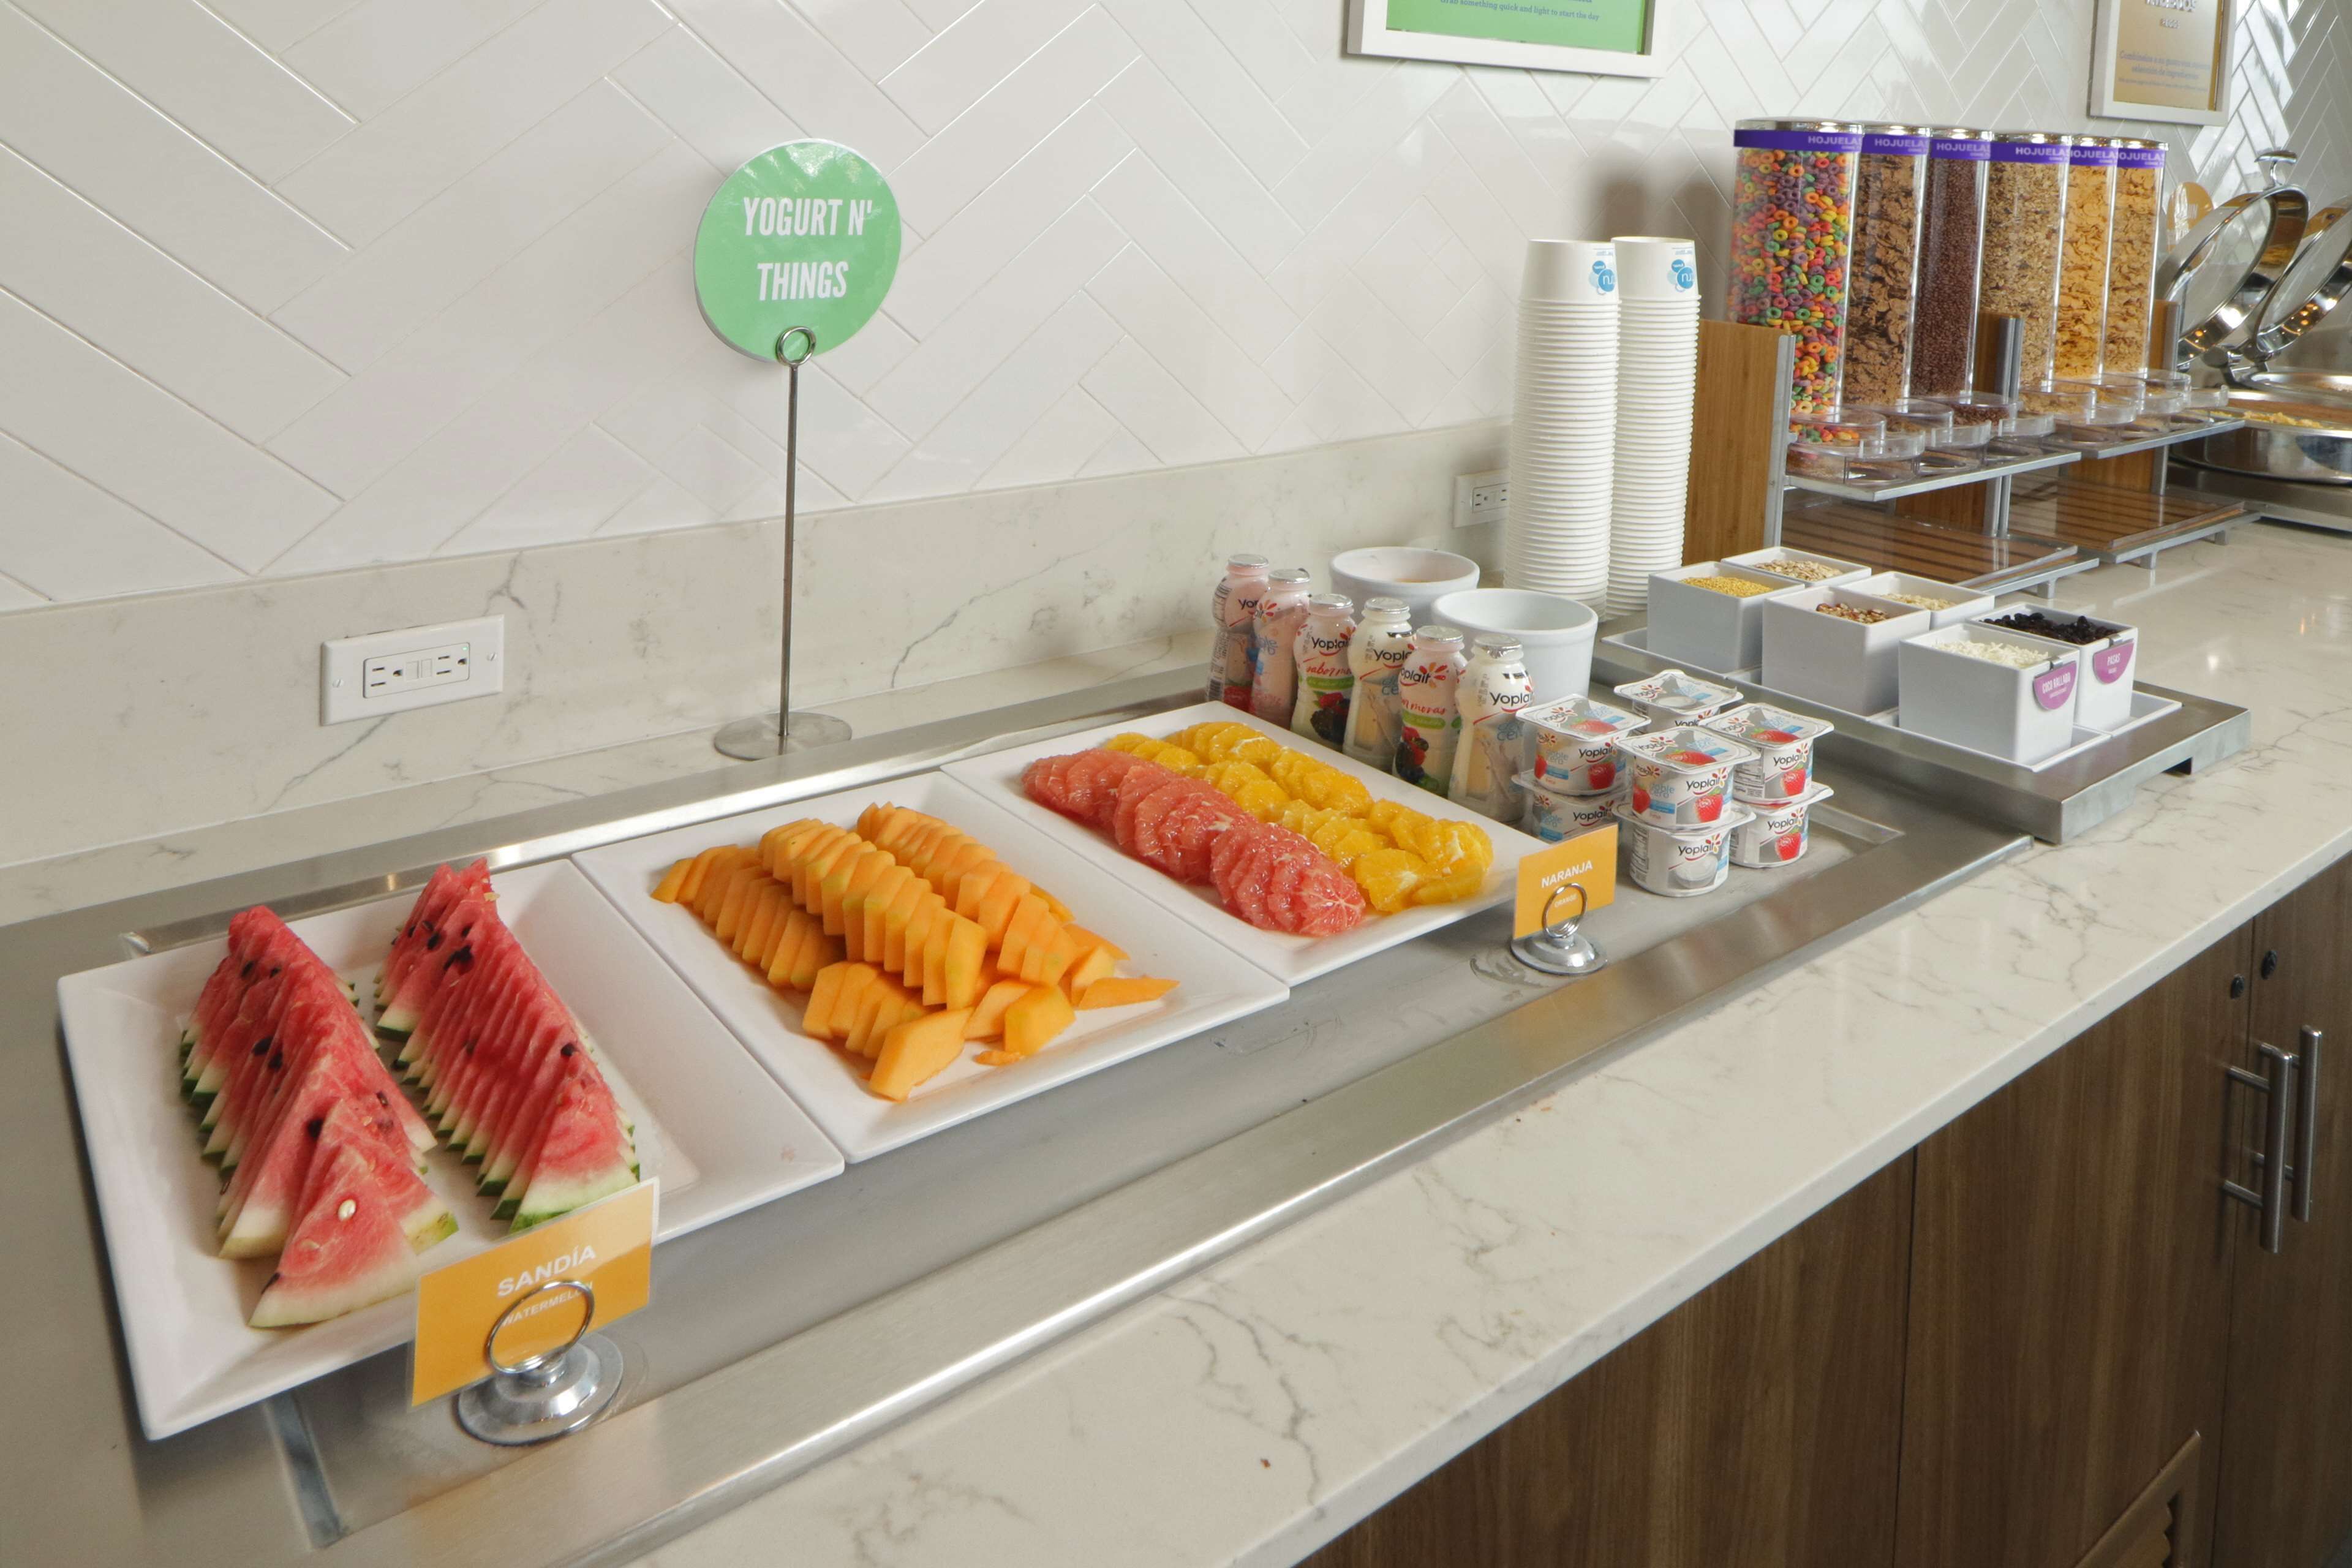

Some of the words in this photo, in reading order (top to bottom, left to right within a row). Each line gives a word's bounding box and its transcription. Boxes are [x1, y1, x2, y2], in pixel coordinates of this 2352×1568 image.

[1460, 0, 1497, 10] something
[1499, 3, 1518, 12] quick
[1588, 13, 1599, 21] day
[743, 197, 843, 236] YOGURT
[848, 199, 873, 236] N'
[757, 261, 849, 301] THINGS
[2107, 652, 2120, 667] PASAS
[1578, 746, 1613, 758] Yoplait
[1686, 778, 1721, 790] Yoplait
[1678, 843, 1714, 856] Yoplait
[1541, 859, 1593, 888] NARANJA
[497, 1245, 597, 1298] SANDÍA
